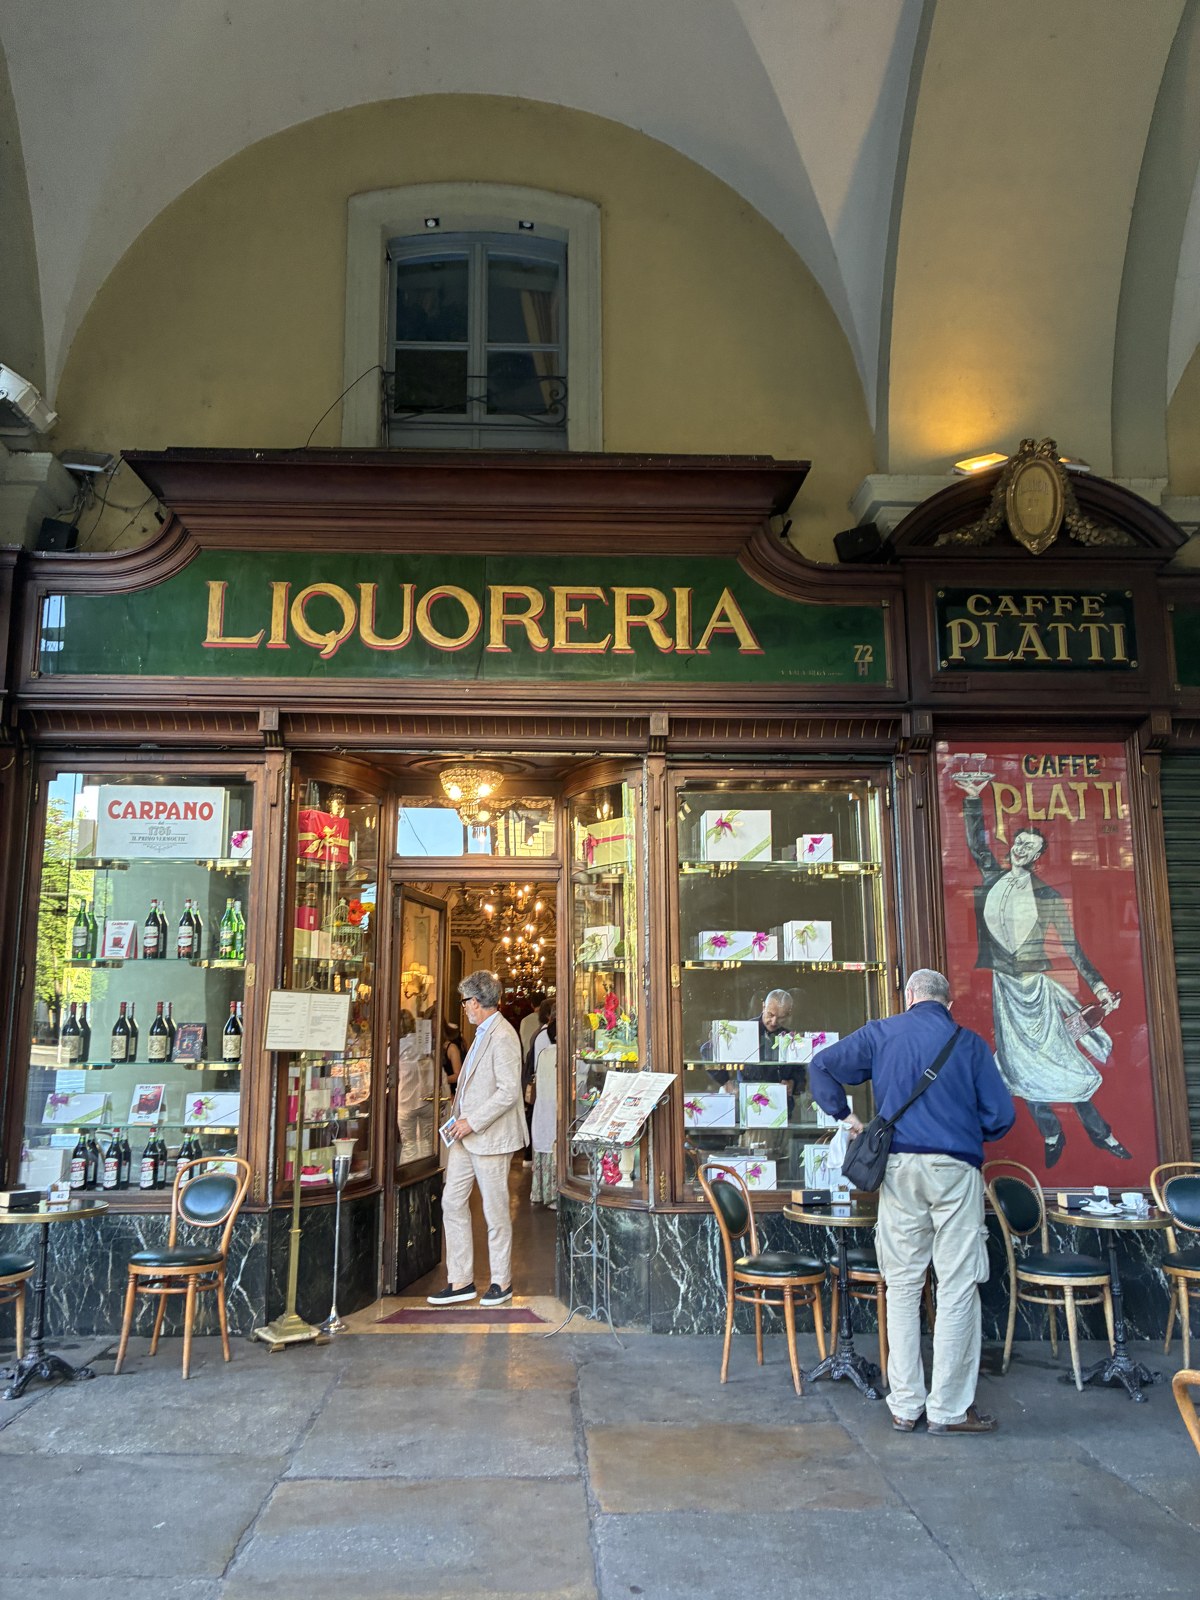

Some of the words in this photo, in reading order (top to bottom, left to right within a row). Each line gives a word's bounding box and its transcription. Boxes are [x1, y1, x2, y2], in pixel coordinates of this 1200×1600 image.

[202, 580, 765, 659] LIQUORERIA
[946, 618, 1129, 662] PLATTI
[853, 644, 873, 663] 72
[107, 799, 214, 821] CARPANO
[990, 780, 1124, 845] PLATTI
